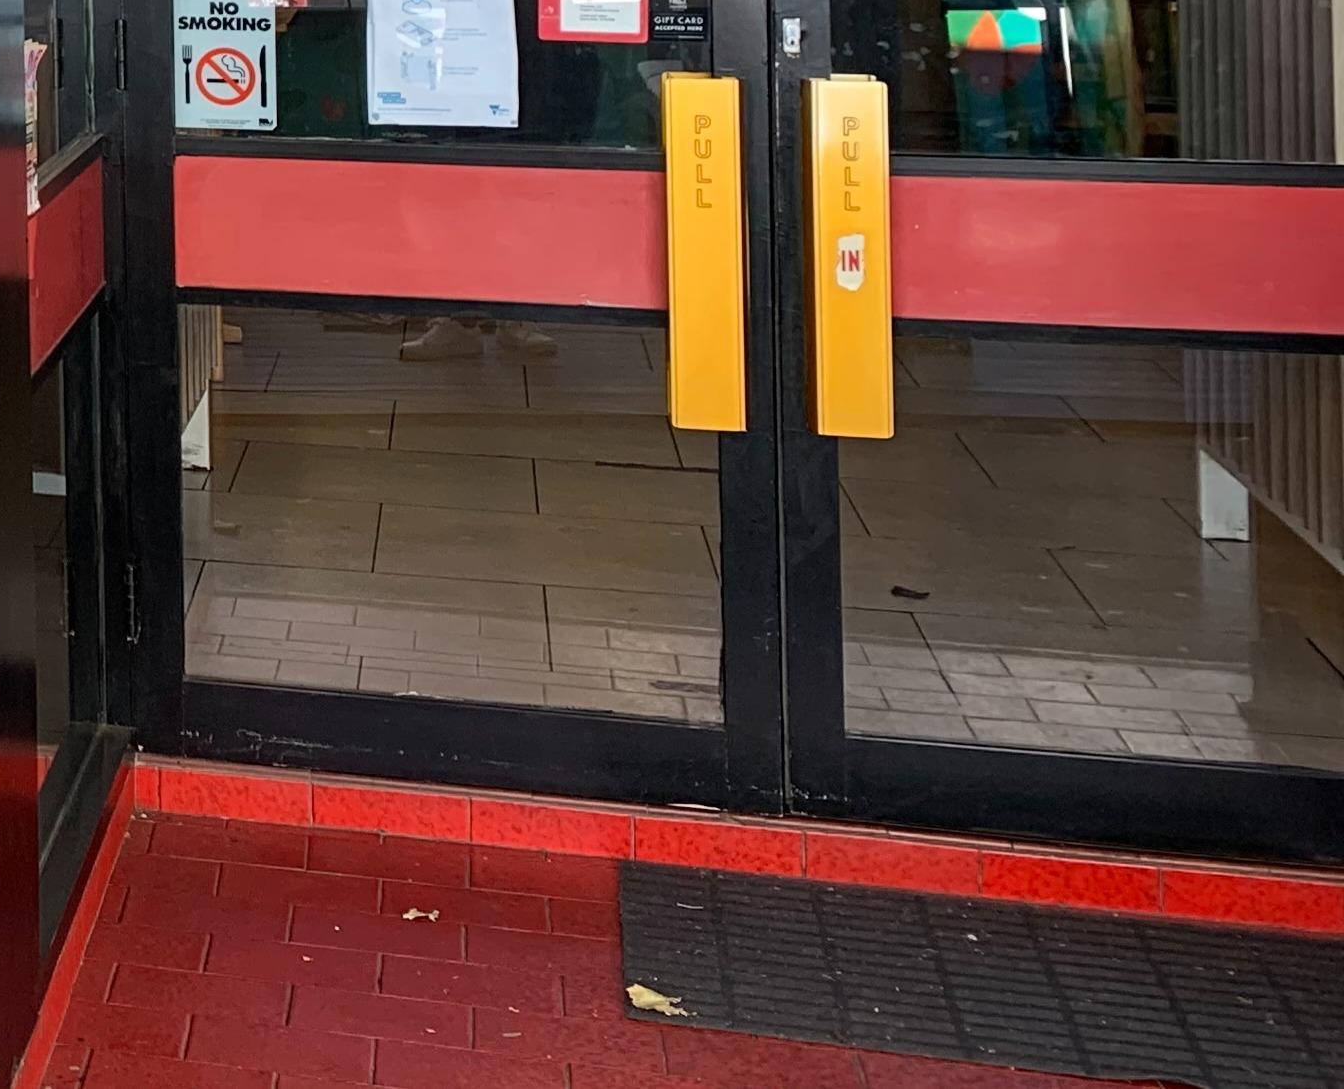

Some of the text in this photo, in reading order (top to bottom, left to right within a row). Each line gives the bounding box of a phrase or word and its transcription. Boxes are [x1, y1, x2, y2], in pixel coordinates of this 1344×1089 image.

[209, 1, 239, 15] NO
[178, 16, 272, 32] SMOKING
[654, 16, 704, 25] GIFT CARD
[694, 115, 712, 208] PULL
[842, 116, 861, 211] PULL
[842, 250, 860, 271] IN
